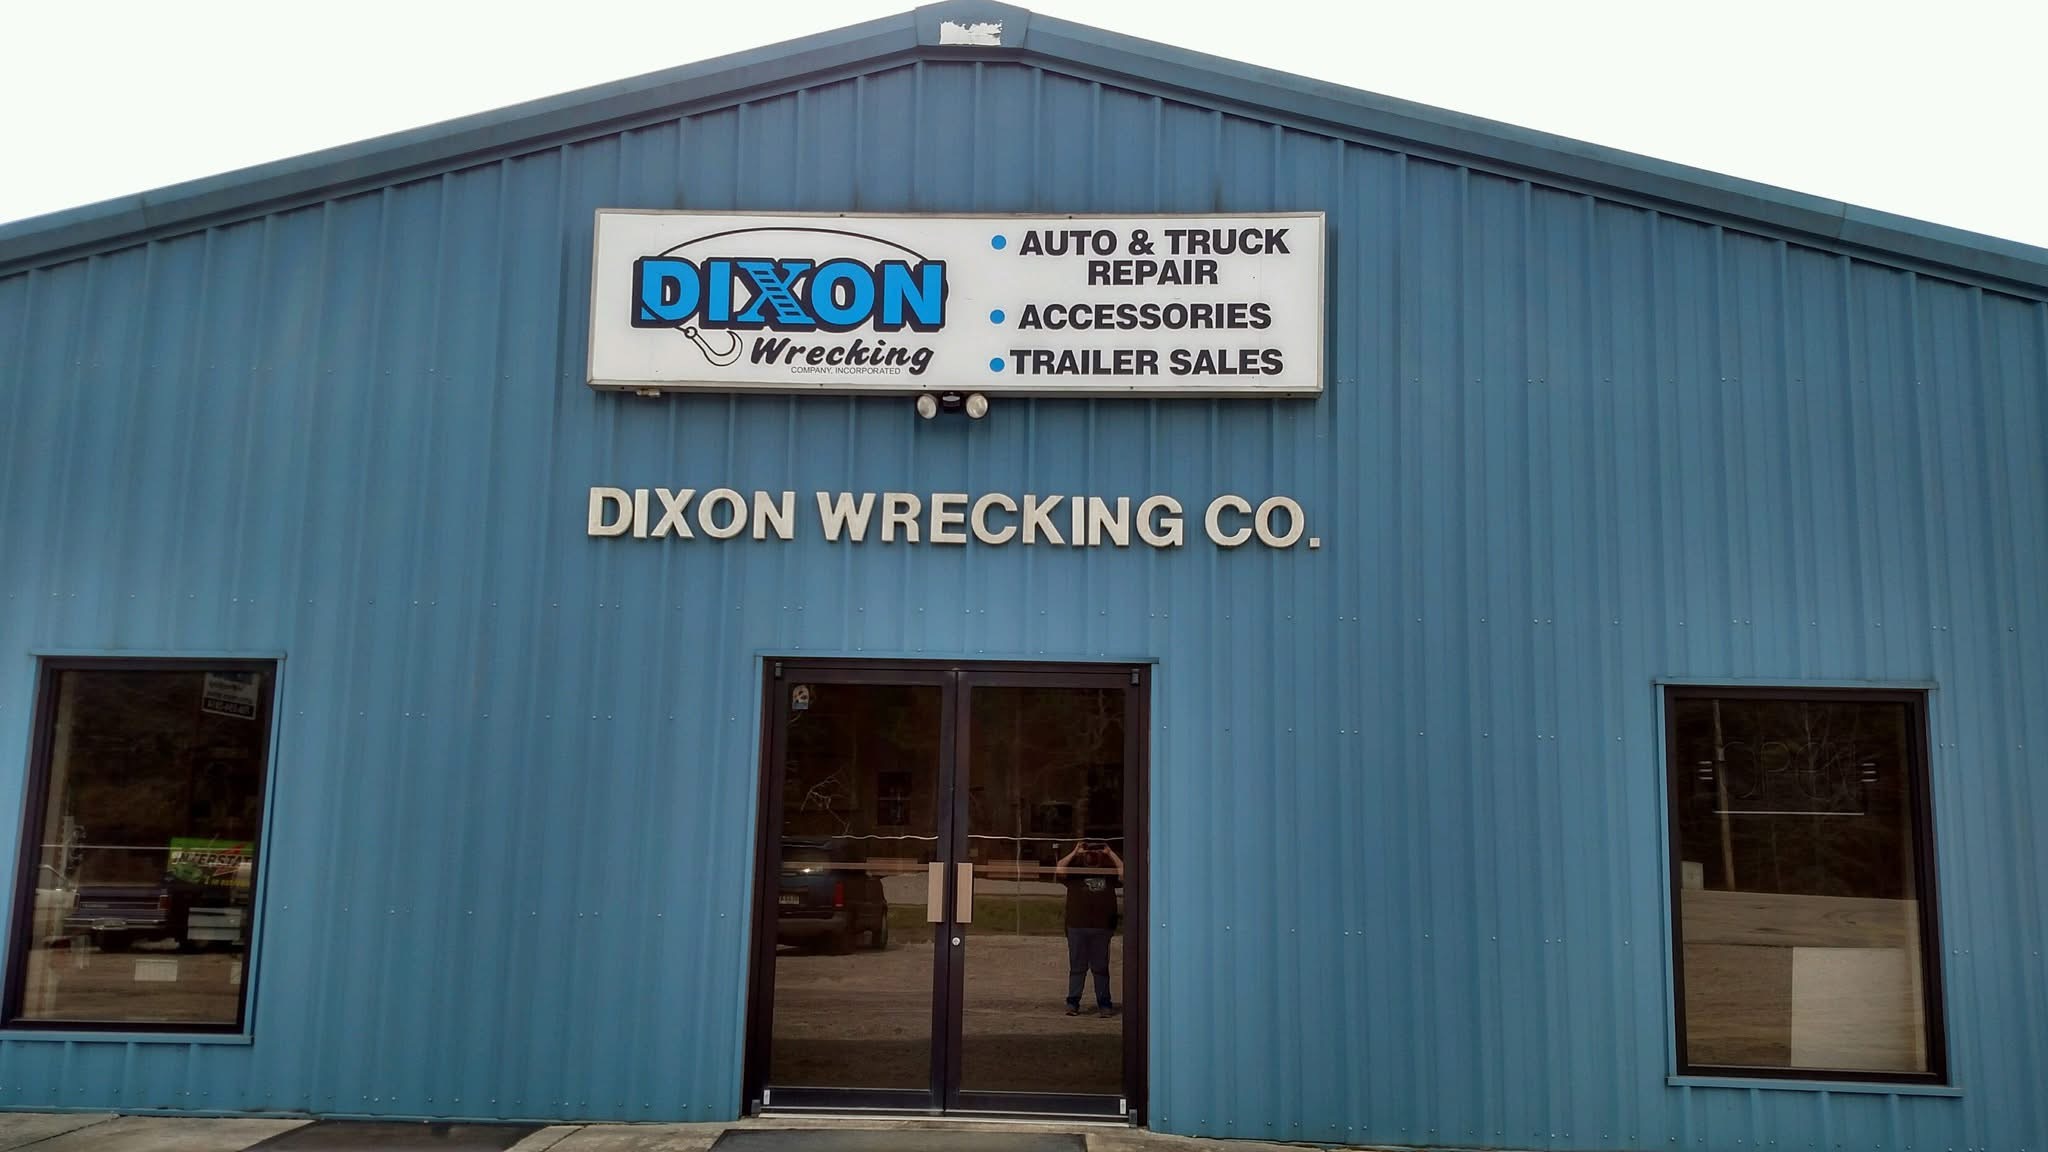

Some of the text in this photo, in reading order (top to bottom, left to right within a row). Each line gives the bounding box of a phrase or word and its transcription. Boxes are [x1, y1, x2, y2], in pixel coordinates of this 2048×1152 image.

[1019, 228, 1291, 256] AUTO & TRUCK
[1087, 259, 1219, 286] REPAIR
[631, 256, 949, 333] DIXON
[1017, 303, 1273, 330] ACCESSORIES
[750, 336, 935, 376] Wrecking
[1009, 349, 1284, 375] TRAILER SALES
[835, 367, 901, 375] INCORPORATED
[587, 486, 1321, 550] DIXON WRECKING CO.
